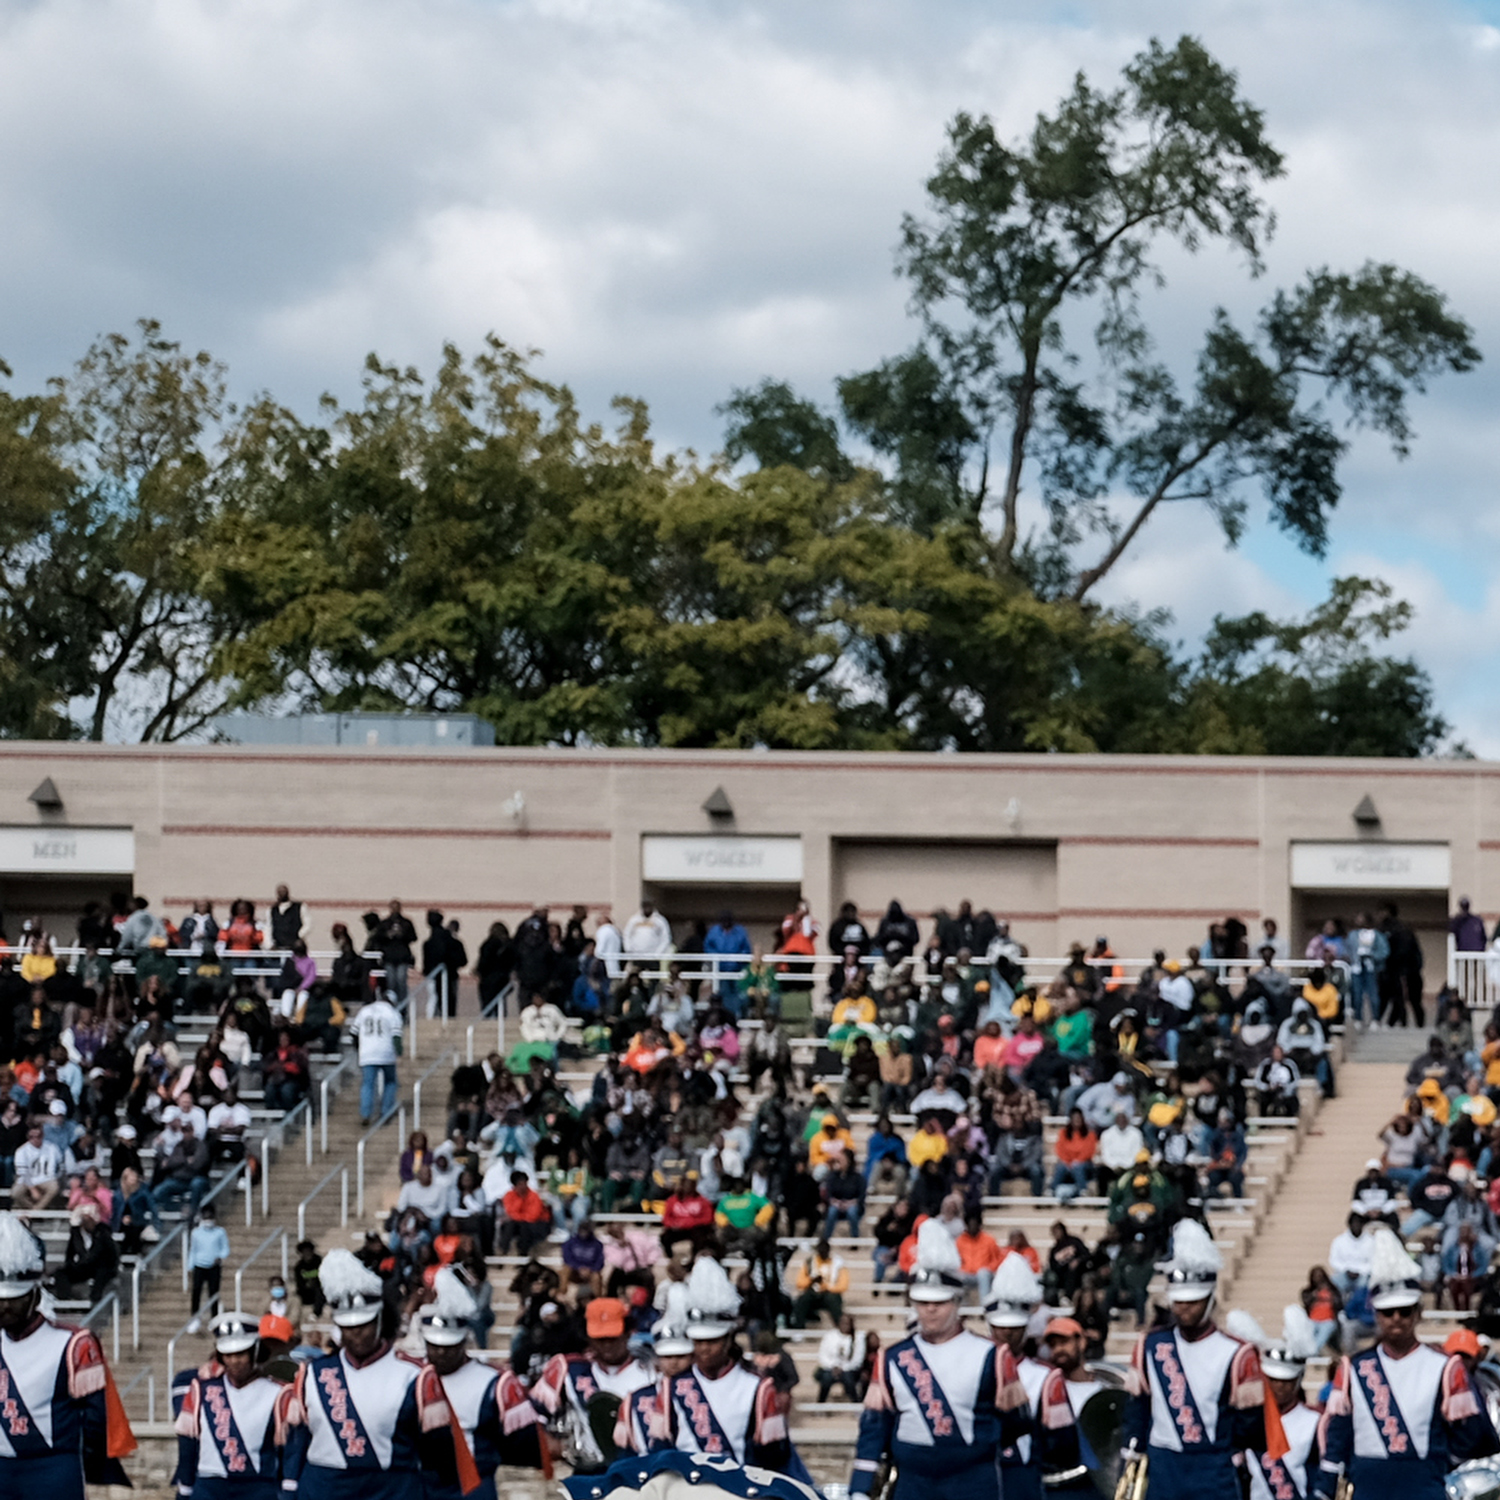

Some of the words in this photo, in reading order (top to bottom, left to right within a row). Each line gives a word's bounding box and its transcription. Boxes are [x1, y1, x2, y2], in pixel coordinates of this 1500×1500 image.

[32, 841, 77, 859] MEN
[683, 850, 765, 867] WOMEN
[205, 1385, 247, 1472] MORGAN
[319, 1367, 366, 1457] MORGAN
[898, 1348, 953, 1437] MORGAN
[1155, 1342, 1202, 1443] MORGAN
[1358, 1358, 1408, 1453] MORGAN
